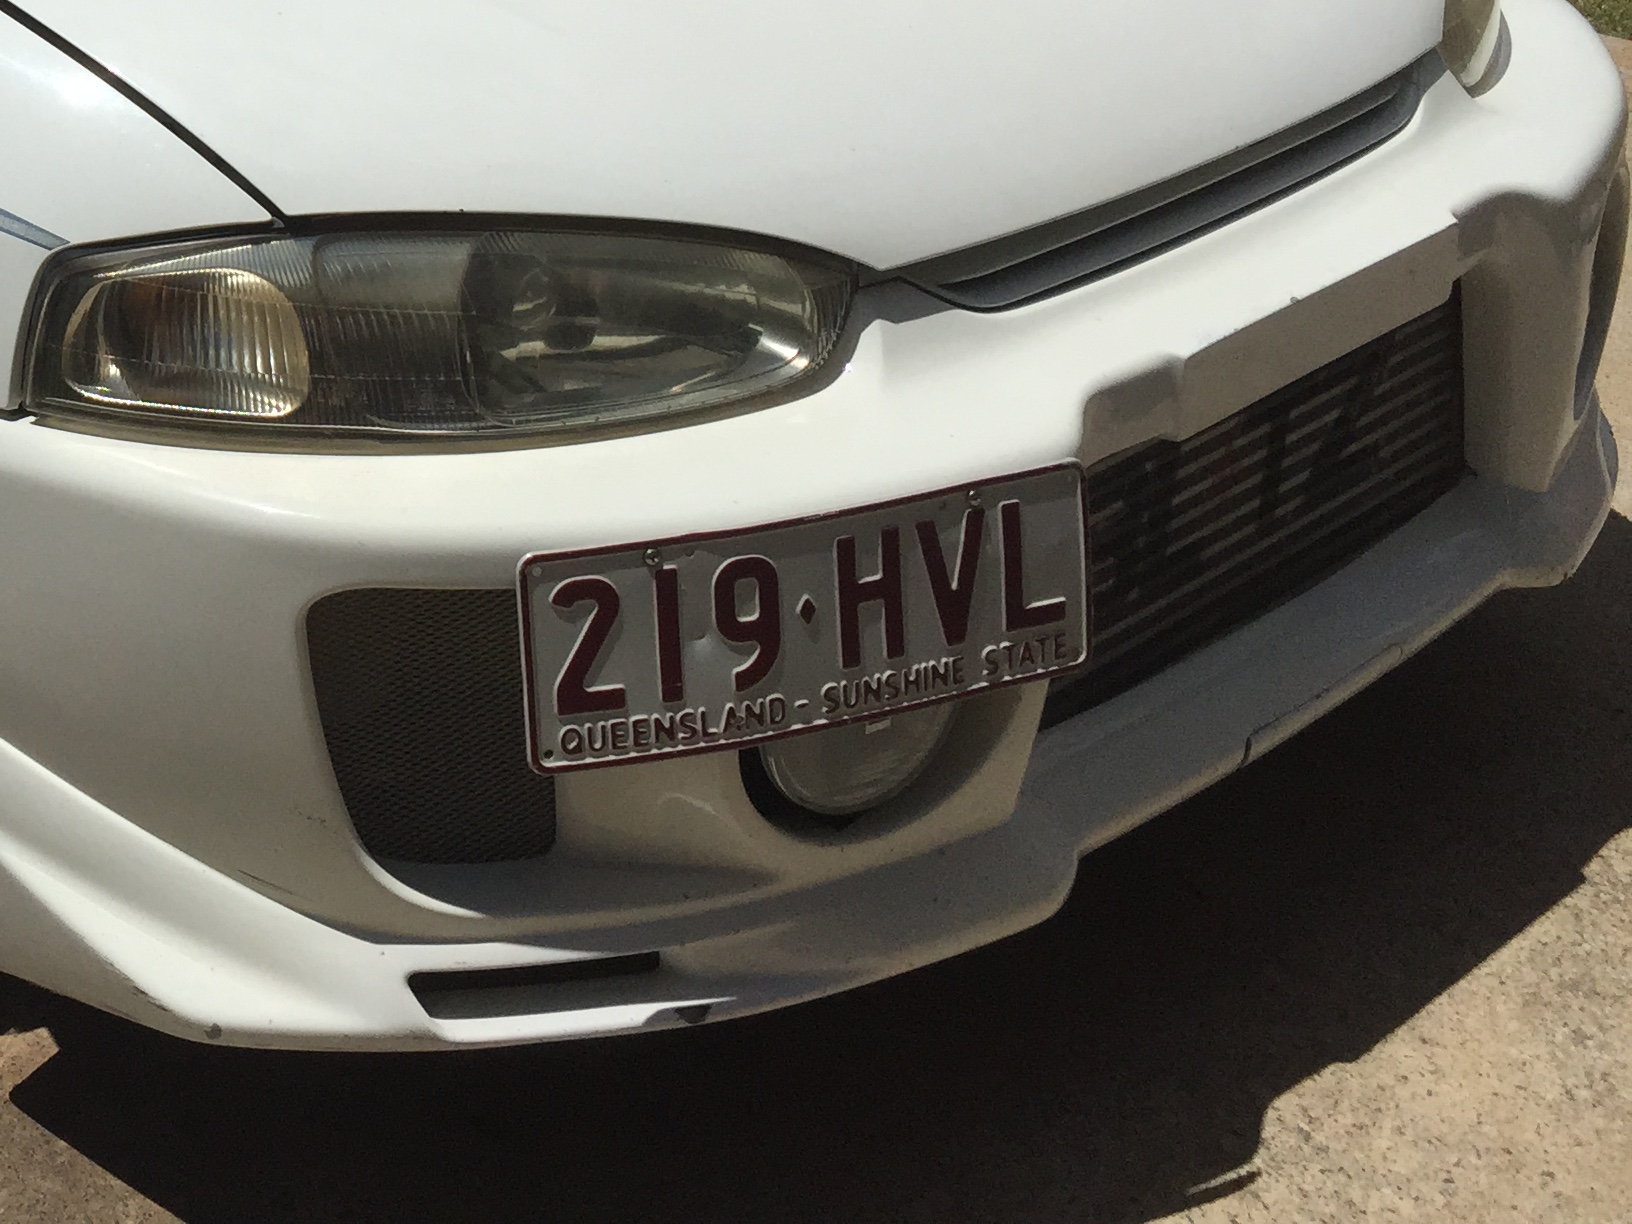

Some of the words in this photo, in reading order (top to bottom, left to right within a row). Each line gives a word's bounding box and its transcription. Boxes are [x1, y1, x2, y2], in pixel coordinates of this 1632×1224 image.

[559, 692, 786, 757] QUEENSLAND
[820, 655, 965, 714] SUNSHINE
[981, 632, 1068, 676] STATE
